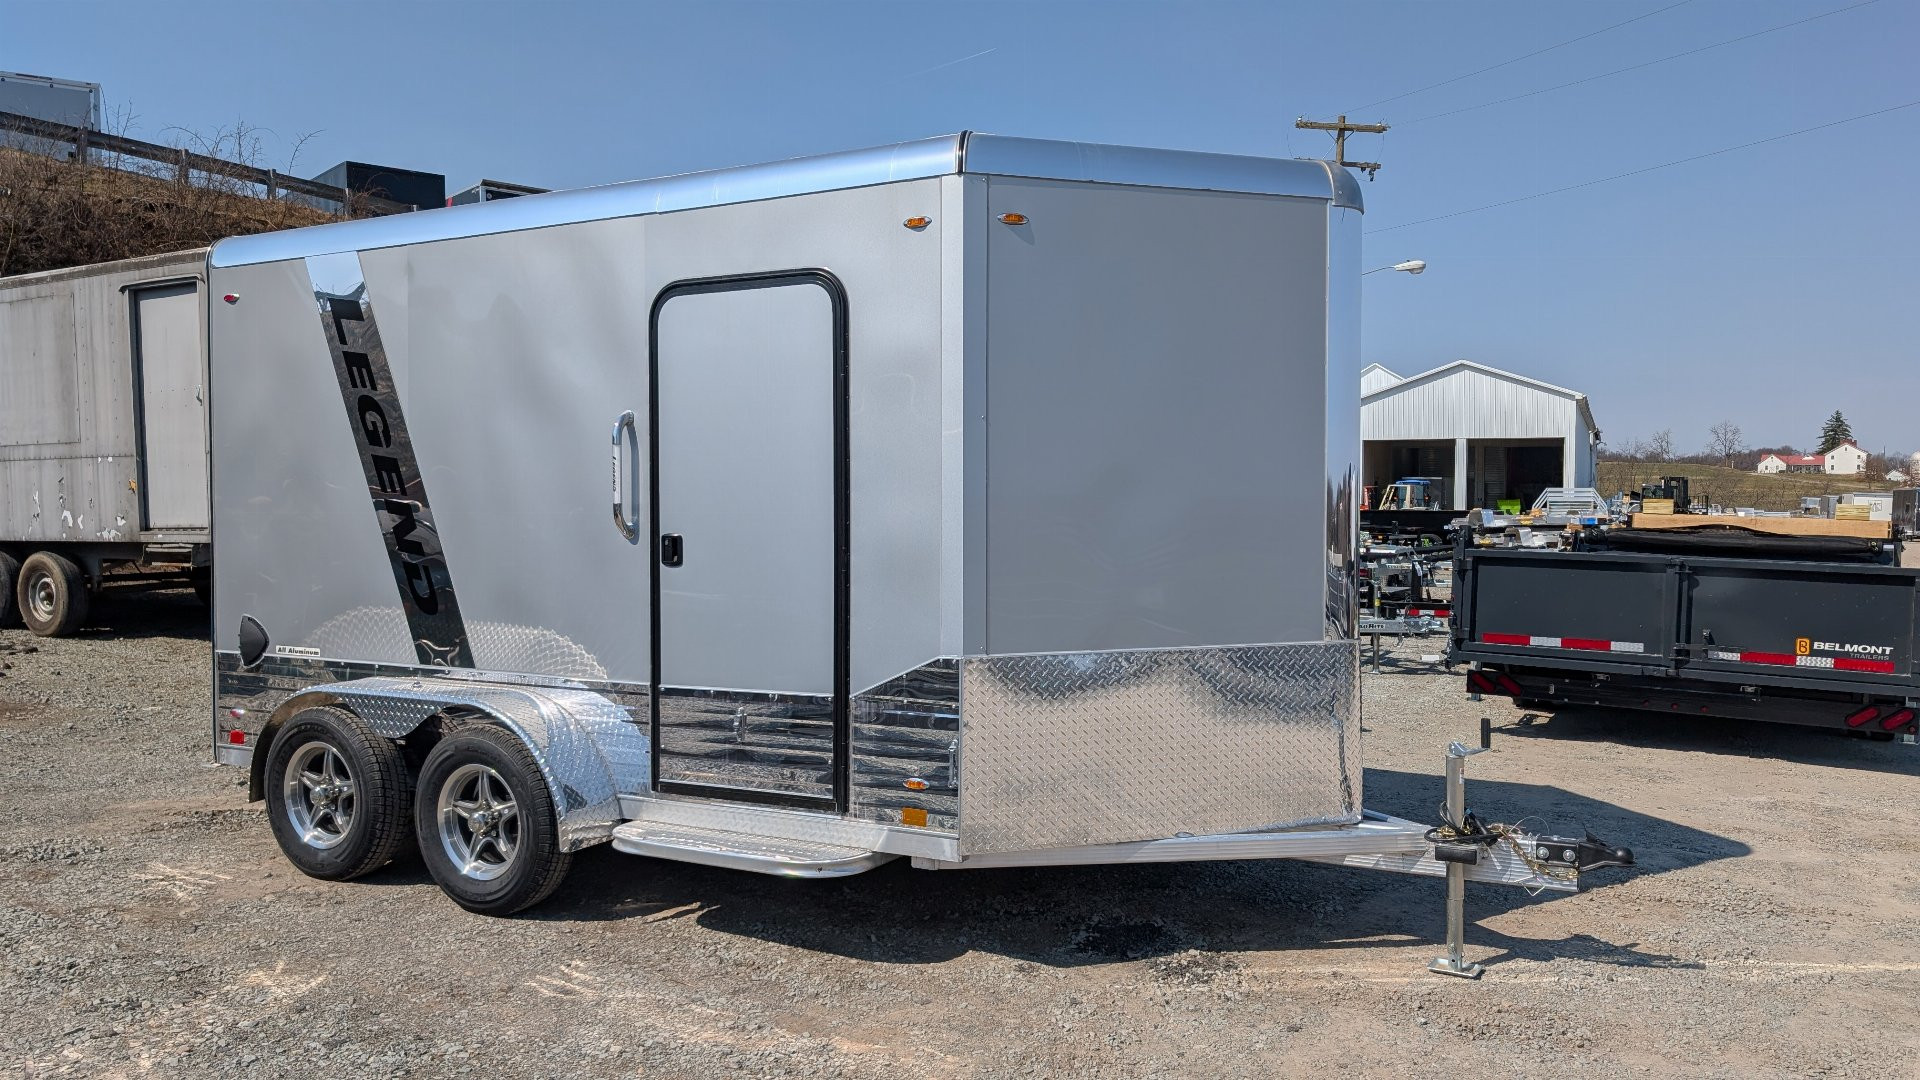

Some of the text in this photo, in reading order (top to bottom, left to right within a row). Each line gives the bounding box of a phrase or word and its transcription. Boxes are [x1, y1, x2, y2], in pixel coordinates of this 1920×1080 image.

[327, 297, 439, 615] LEGEND
[288, 647, 319, 655] Aluminum
[1813, 641, 1894, 654] BELMONT
[1849, 653, 1890, 661] TRAILERS
